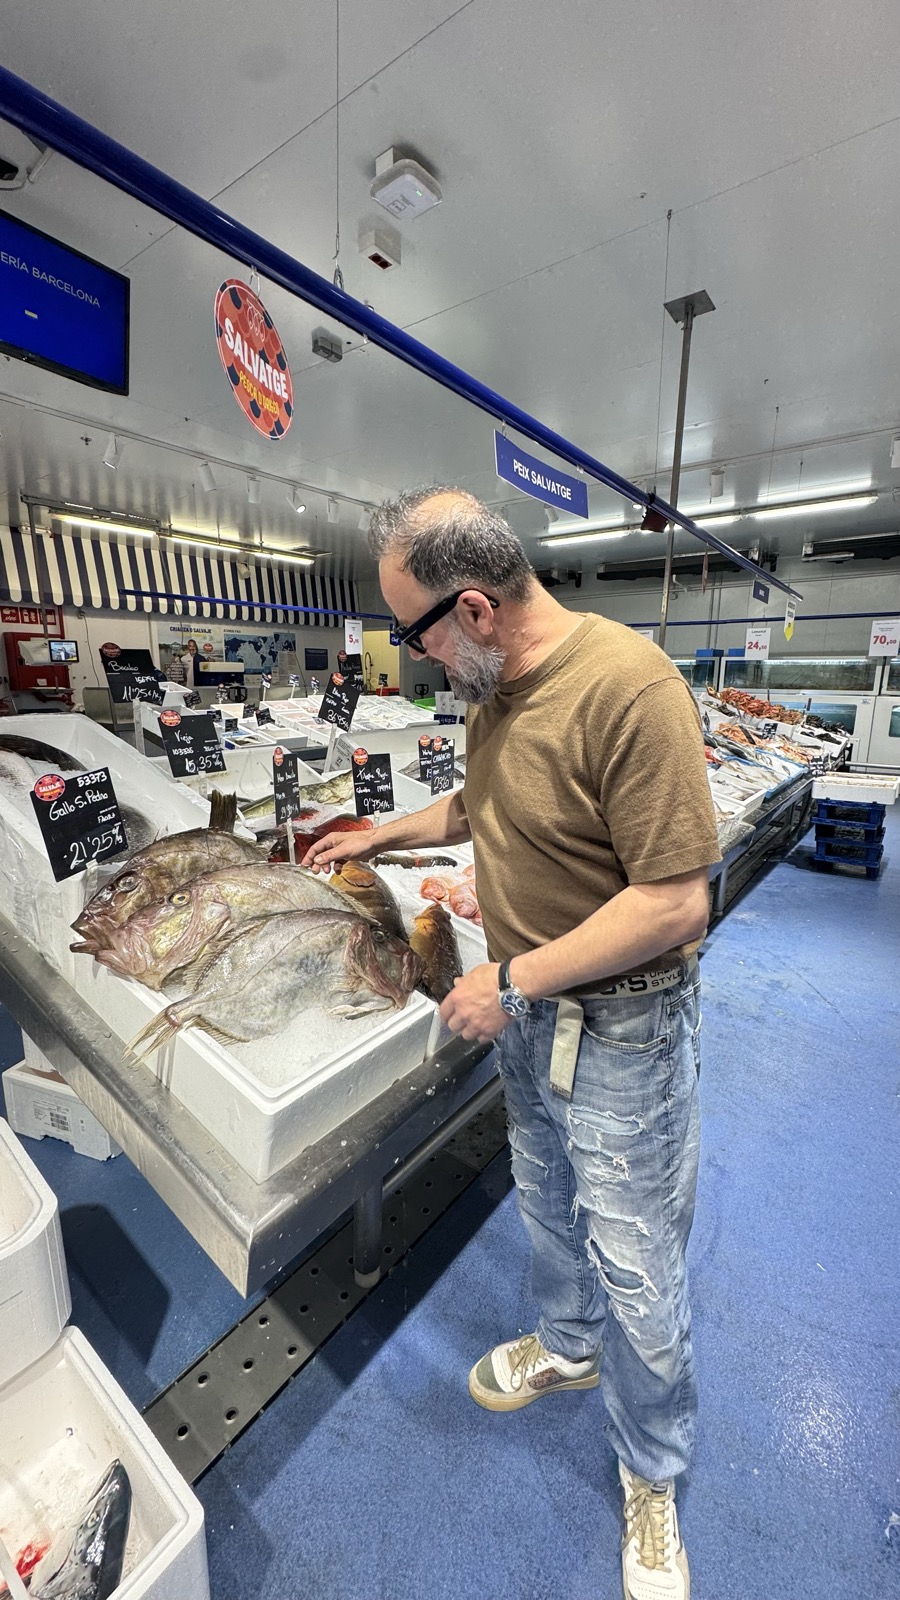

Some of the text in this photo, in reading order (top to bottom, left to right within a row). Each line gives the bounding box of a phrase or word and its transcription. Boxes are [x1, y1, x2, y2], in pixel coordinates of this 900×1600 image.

[32, 266, 100, 308] BARCELONA
[224, 317, 289, 399] SALVATGE
[513, 459, 572, 501] PEIX SALVATGE
[747, 641, 768, 651] 24,50
[873, 635, 897, 646] 70,00
[76, 770, 108, 787] 53373
[39, 783, 62, 793] SALVAJE
[49, 800, 76, 821] Gallo
[85, 789, 109, 804] Pedro
[651, 969, 683, 987] STYLE
